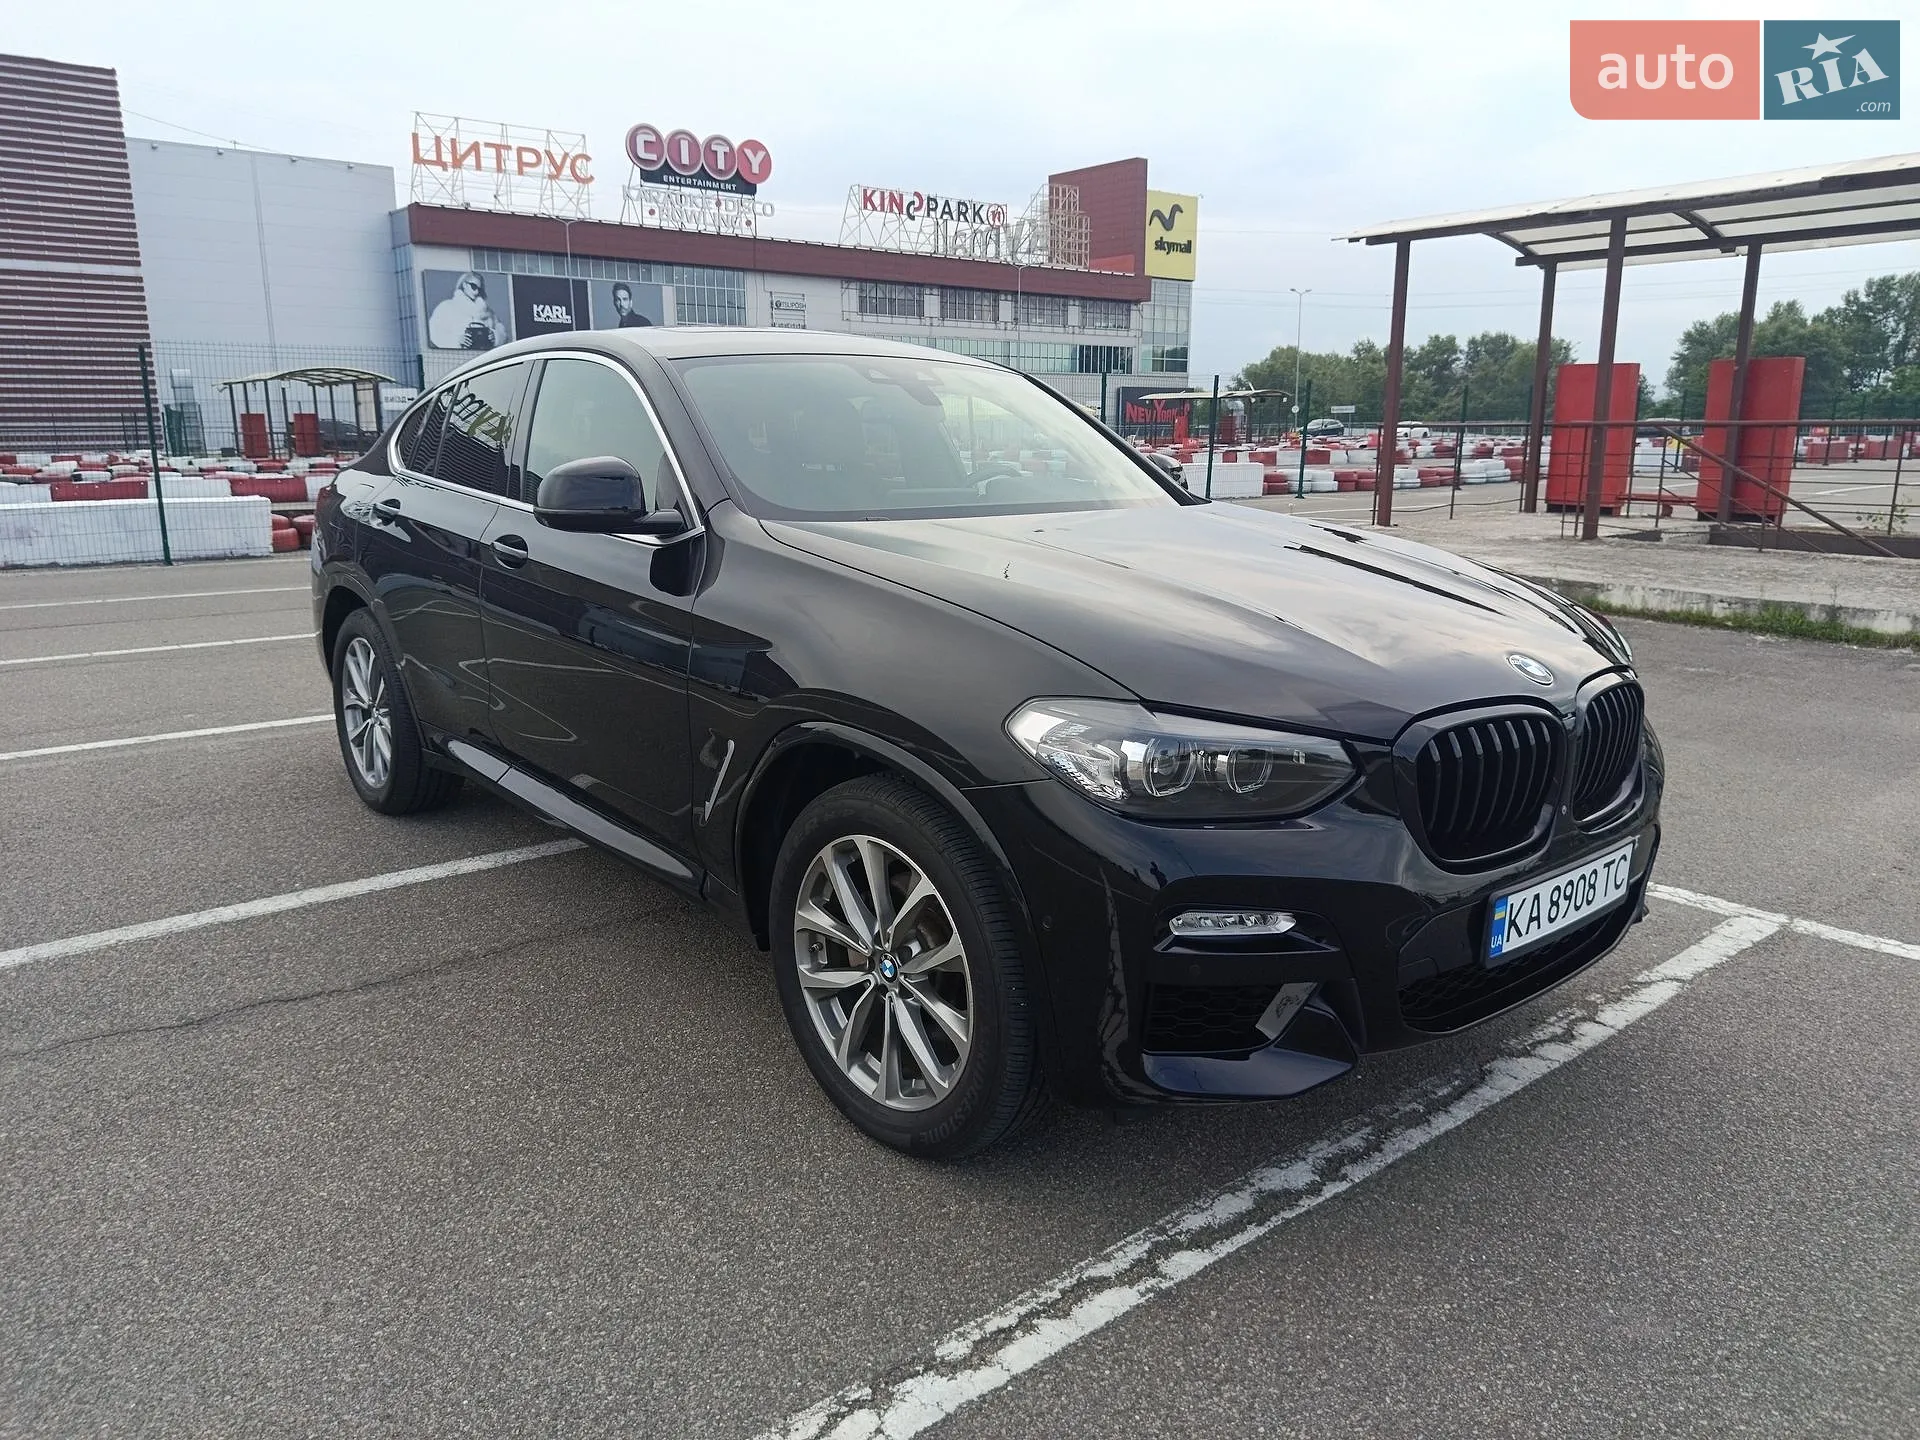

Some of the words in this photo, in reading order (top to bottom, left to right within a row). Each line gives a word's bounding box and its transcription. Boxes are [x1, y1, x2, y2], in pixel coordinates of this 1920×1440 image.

[411, 131, 596, 185] ЦИТРУС
[635, 130, 770, 177] CITY
[663, 174, 738, 191] ENTERTAINMENT
[1154, 236, 1192, 255] skymall
[533, 303, 571, 319] KARL
[1505, 892, 1542, 943] KA
[1547, 868, 1598, 924] 8908
[1602, 853, 1628, 898] TC
[1490, 933, 1503, 949] UA
